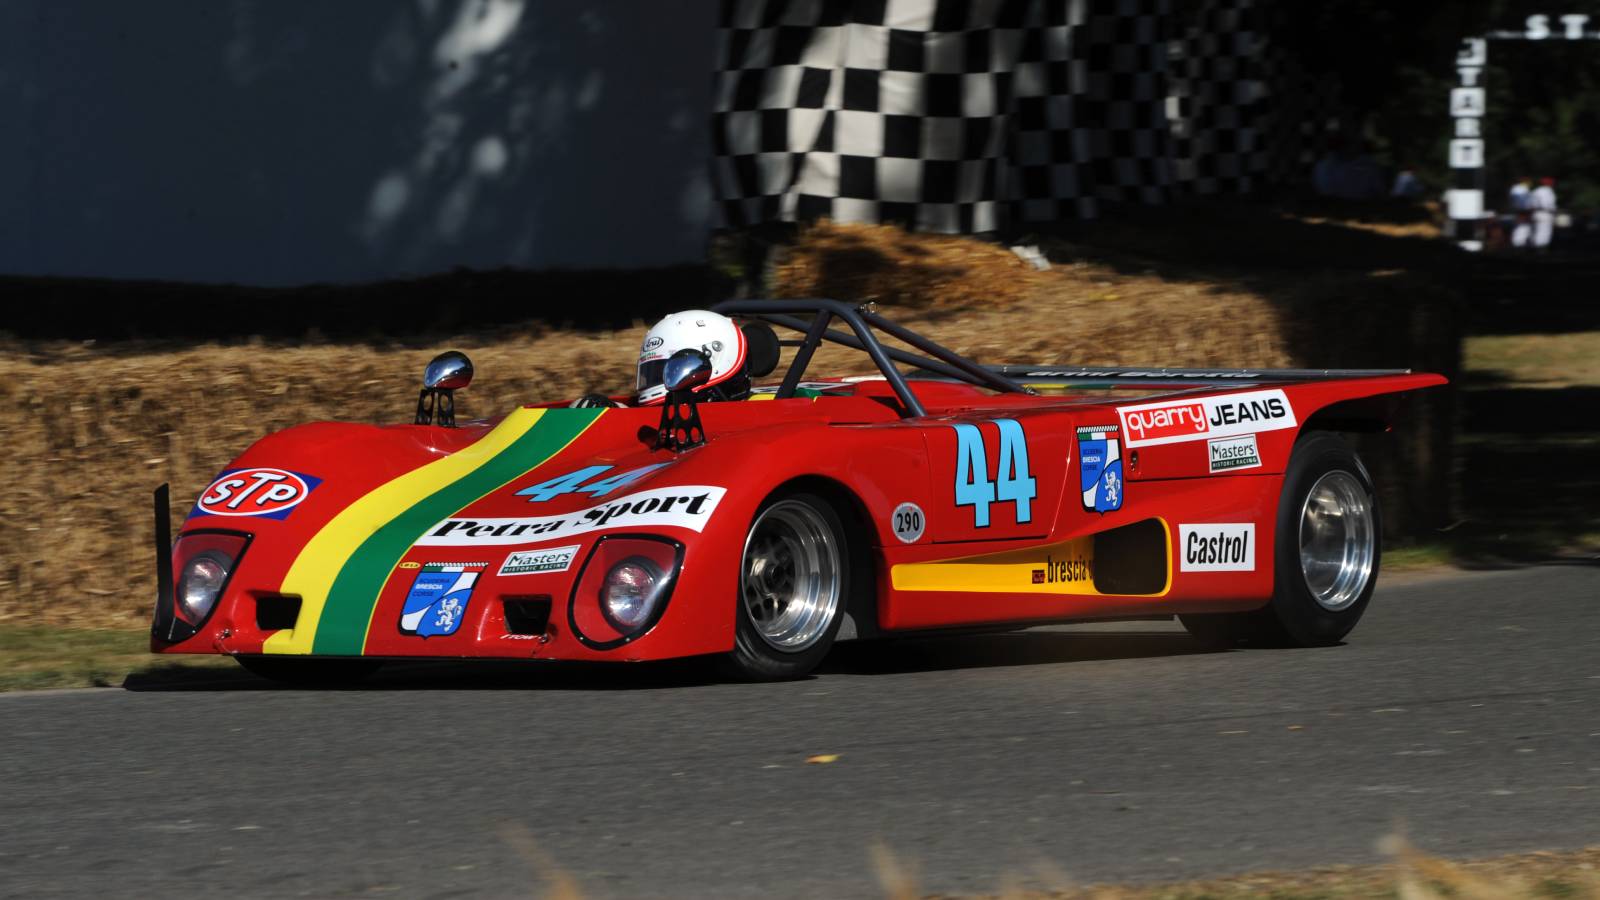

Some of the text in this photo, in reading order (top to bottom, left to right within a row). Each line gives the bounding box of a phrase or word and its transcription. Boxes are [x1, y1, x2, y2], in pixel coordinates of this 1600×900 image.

[1525, 14, 1600, 40] ST
[1127, 398, 1286, 438] quarry JEANS
[1212, 445, 1255, 460] Masters
[1212, 457, 1258, 468] HISTORIC RACING
[514, 461, 677, 502] 44
[954, 418, 1037, 528] 44
[203, 472, 298, 508] STP
[428, 491, 713, 538] Petra Sport
[896, 512, 920, 532] 290
[508, 553, 571, 566] Masters
[1187, 530, 1248, 565] Castrol
[503, 562, 567, 573] HISTORIC RACING
[1047, 555, 1086, 583] brescia
